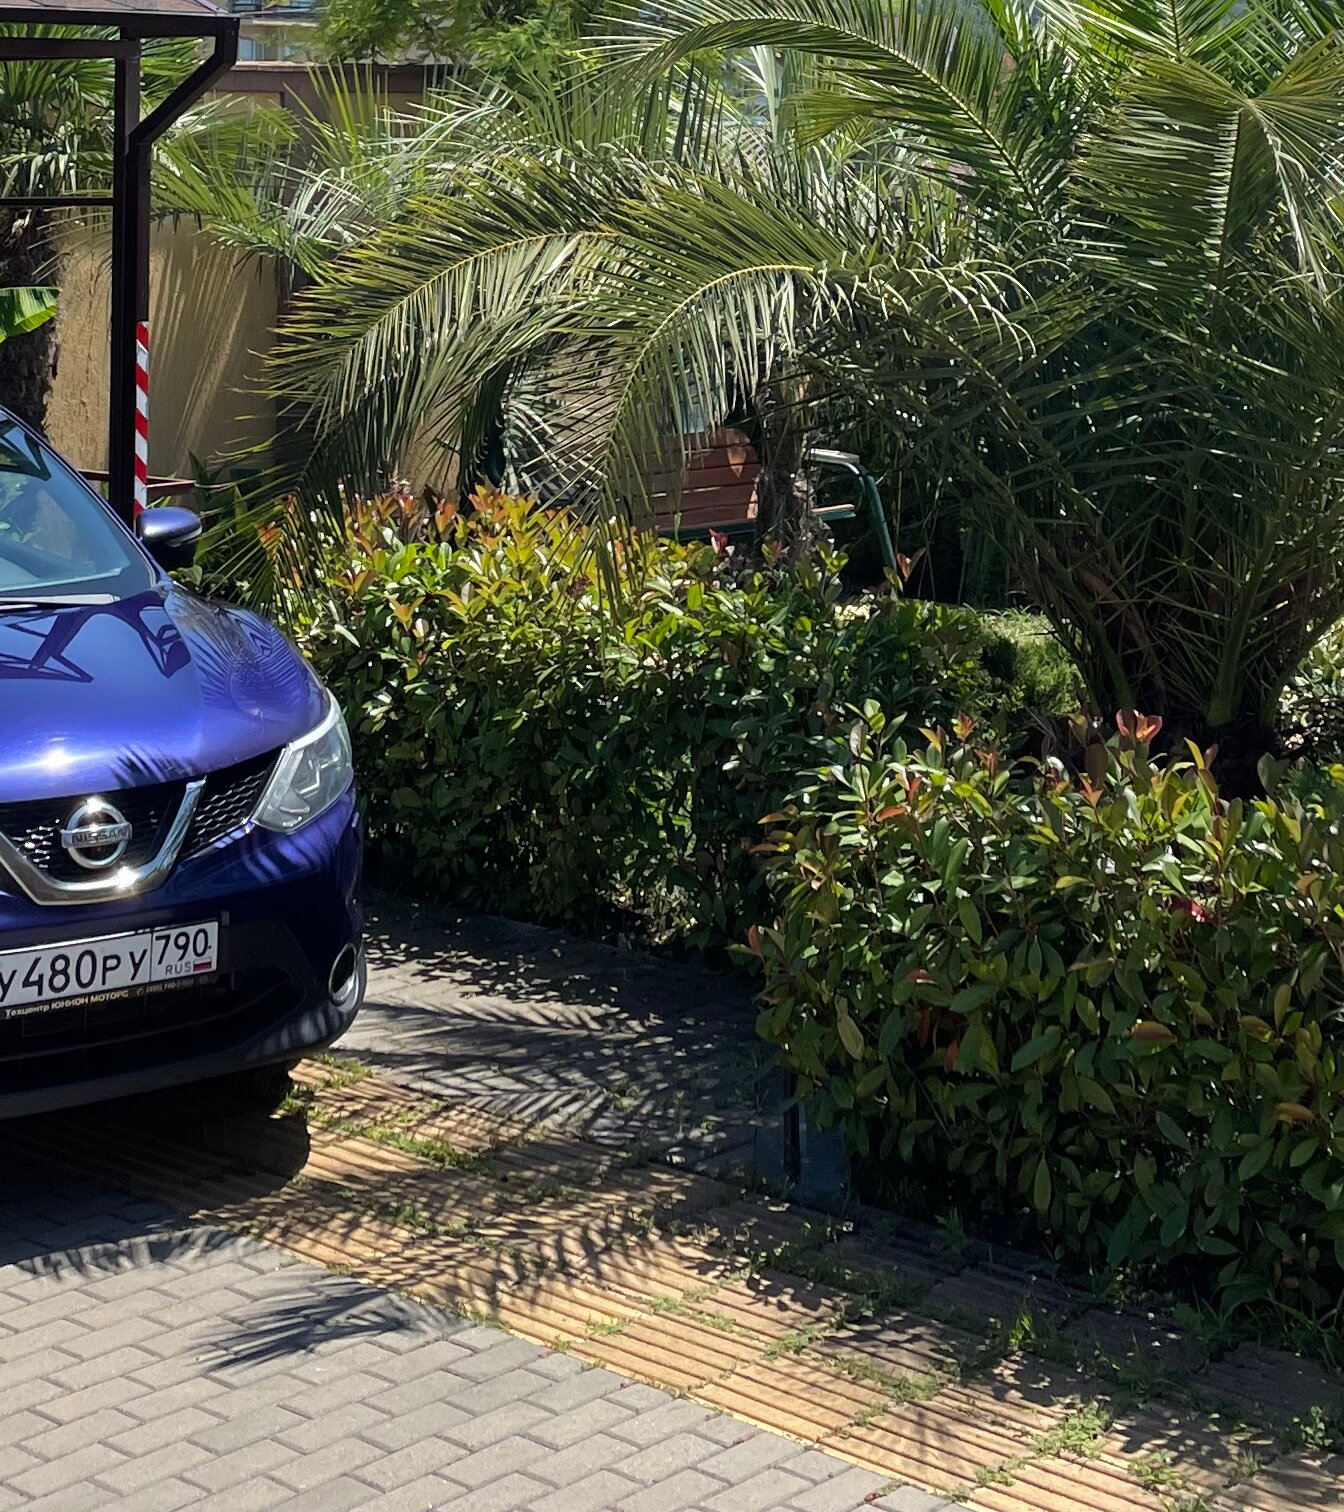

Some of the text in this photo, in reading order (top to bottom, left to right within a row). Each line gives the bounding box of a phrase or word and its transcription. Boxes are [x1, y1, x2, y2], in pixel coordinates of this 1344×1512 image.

[72, 827, 131, 844] NISSAN
[155, 928, 209, 965] 790
[165, 962, 192, 976] RUS
[90, 990, 129, 1003] МОТОРС
